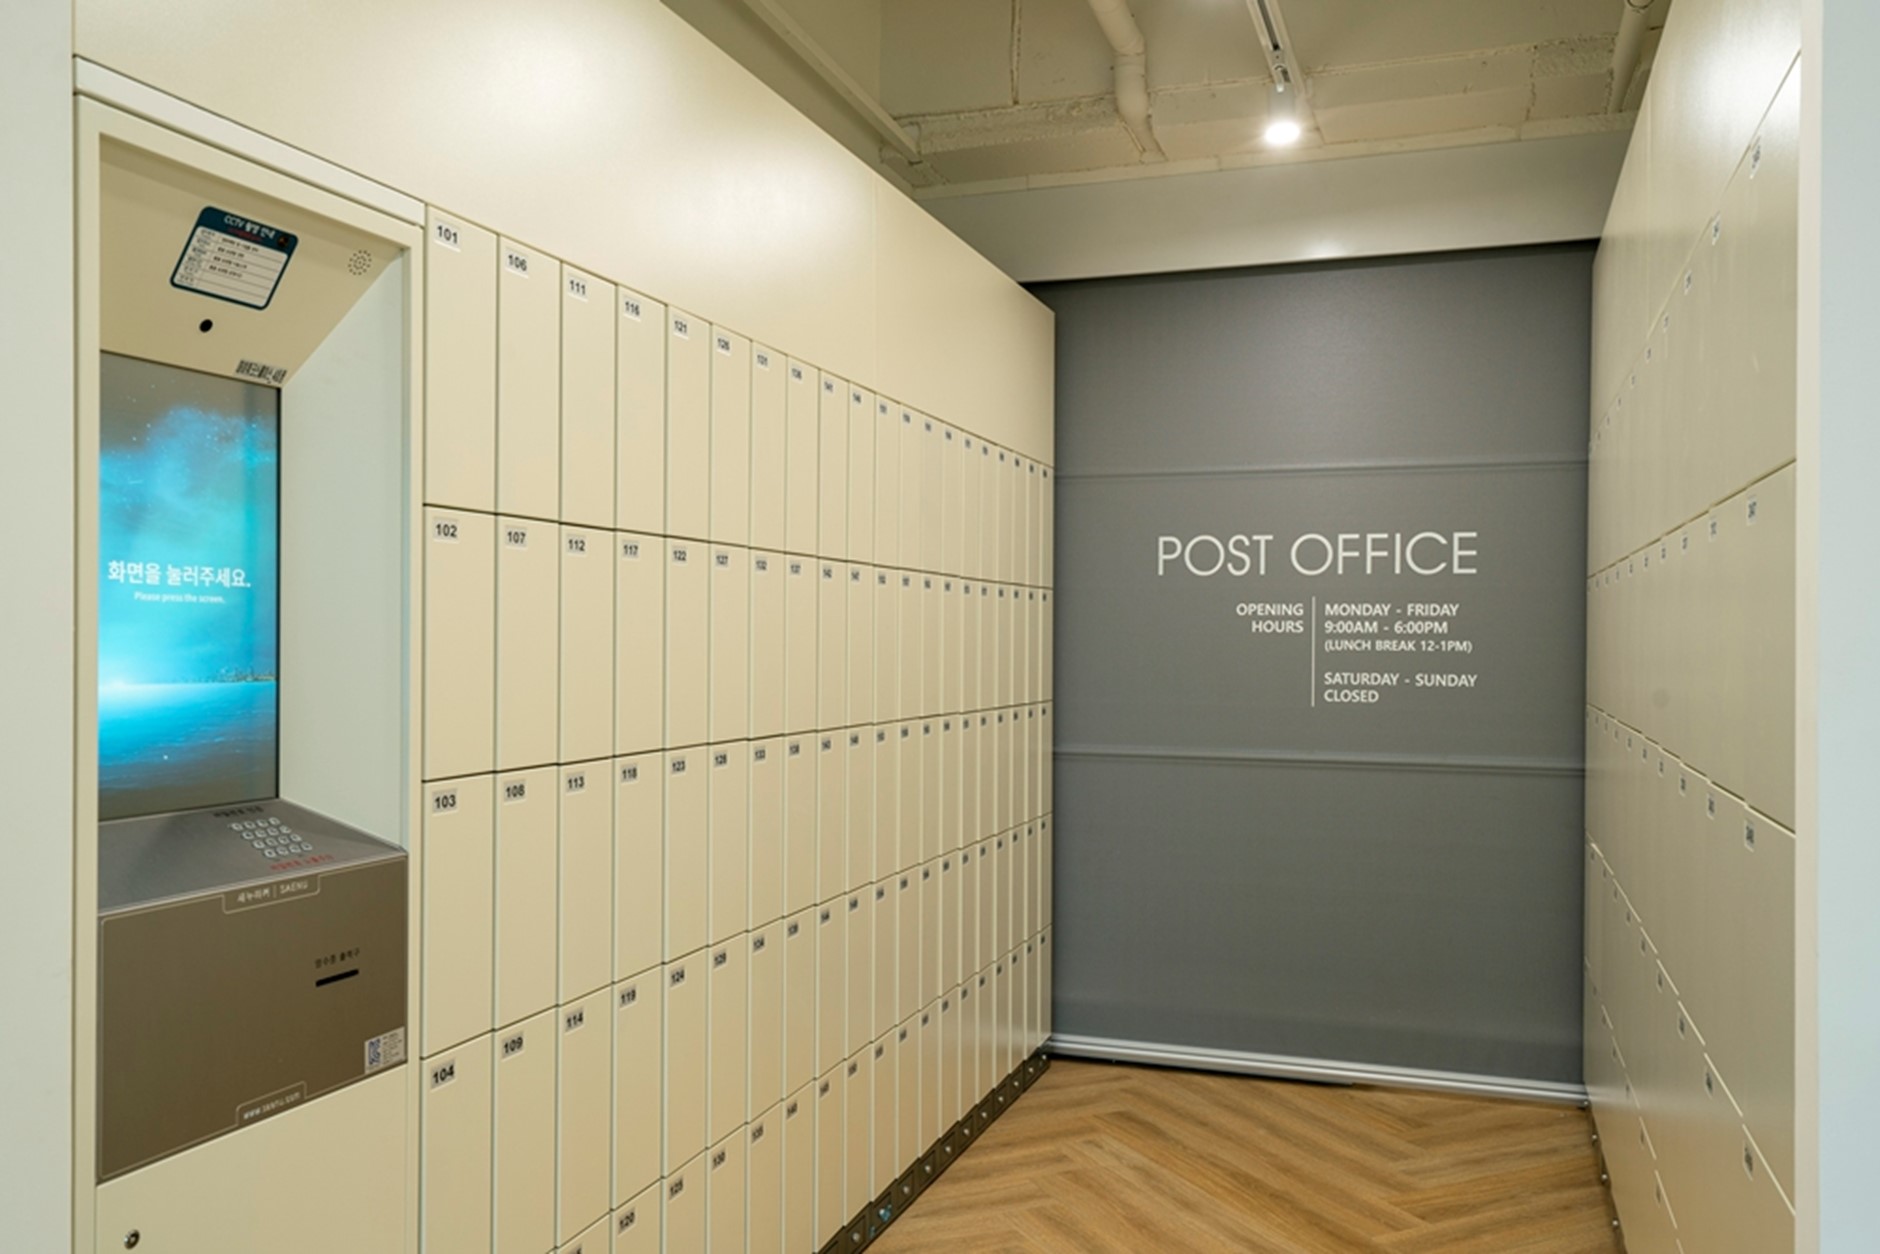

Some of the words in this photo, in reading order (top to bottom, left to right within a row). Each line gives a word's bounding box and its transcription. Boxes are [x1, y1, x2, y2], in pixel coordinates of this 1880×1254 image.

[437, 225, 458, 244] 101
[508, 254, 527, 271] 106
[569, 280, 586, 296] 111
[625, 301, 640, 316] 116
[674, 320, 687, 333] 121
[436, 524, 457, 538] 102
[507, 531, 526, 544] 107
[568, 539, 585, 552] 112
[624, 545, 638, 556] 117
[673, 550, 686, 561] 122
[1158, 534, 1274, 576] POST
[1290, 531, 1478, 576] OFFICE
[108, 560, 161, 585] 화면을
[166, 564, 251, 588] 눌러주세요.
[1236, 604, 1304, 616] OPENING
[1324, 604, 1391, 616] MONDAY
[1407, 604, 1460, 616] FRIDAY
[1252, 621, 1304, 633] HOURS
[1324, 621, 1378, 633] 9:00AM
[1394, 621, 1448, 634] 6:00PM
[1324, 640, 1371, 652] (LUNCH
[1375, 640, 1416, 652] BREAK
[1420, 640, 1472, 653] 12-1PM)
[1324, 673, 1400, 686] SATURDAY
[1415, 674, 1478, 687] SUNDAY
[1324, 690, 1379, 702] CLOSED
[622, 767, 637, 779] 118
[672, 761, 685, 772] 123
[568, 776, 584, 789] 113
[505, 785, 525, 798] 108
[435, 795, 456, 808] 103
[671, 969, 685, 983] 124
[620, 989, 636, 1005] 119
[566, 1012, 583, 1028] 114
[503, 1037, 523, 1054] 109
[433, 1065, 454, 1084] 104
[669, 1178, 683, 1197] 125
[619, 1210, 635, 1231] 120
